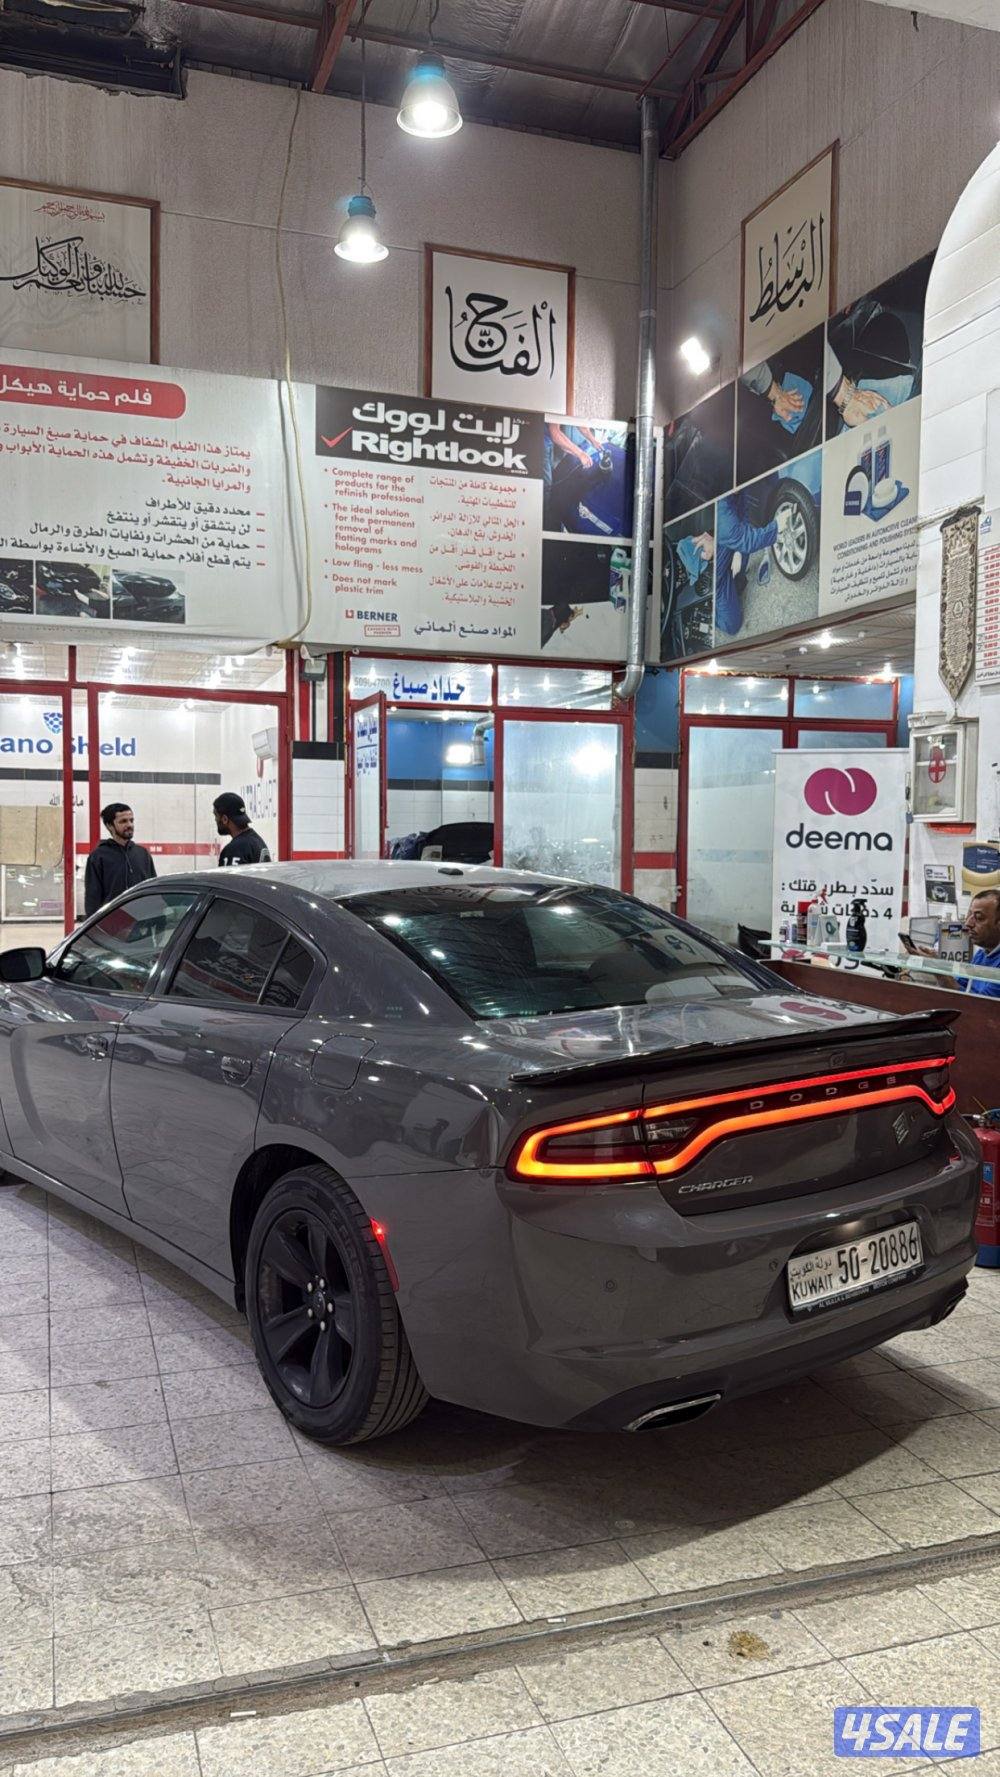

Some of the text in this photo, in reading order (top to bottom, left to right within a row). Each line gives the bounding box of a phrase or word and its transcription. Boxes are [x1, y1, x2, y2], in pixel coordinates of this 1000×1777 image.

[58, 380, 110, 401] حماية
[114, 388, 152, 406] فلم
[352, 401, 520, 445] رايت لووك
[3, 422, 251, 459] يمتاز هذا الفيلم الشفاف في حماية صبغ السيارة
[48, 443, 90, 457] الحماية
[92, 448, 115, 460] هذه
[351, 429, 526, 470] Rightlook
[157, 454, 199, 469] الخفيفة
[201, 460, 251, 477] والضربات
[332, 467, 415, 484] Complete range of
[211, 479, 251, 493] والمرايا
[335, 479, 406, 492] products for the
[335, 488, 425, 504] refinish professional
[193, 502, 220, 514] دقيق
[222, 506, 251, 517] محدد
[332, 503, 410, 518] The ideal solution
[106, 510, 139, 525] ينتفخ
[153, 515, 187, 530] يتقشر
[335, 513, 415, 528] for the permanent
[200, 520, 236, 535] يتشقق
[239, 524, 250, 535] لن
[335, 524, 384, 535] removal of
[29, 522, 250, 551] حماية من الحشرات ونفايات الطرق والرمال
[335, 532, 417, 548] flatting marks and
[11, 536, 54, 553] بواسطة
[107, 544, 139, 559] الصبغ
[335, 542, 382, 554] holograms
[142, 547, 176, 561] حماية
[206, 554, 231, 568] قطع
[232, 556, 251, 569] يتم
[332, 558, 350, 567] Low
[353, 559, 373, 571] fling
[382, 561, 399, 572] less
[401, 565, 423, 574] mess
[332, 573, 398, 587] Does not mark
[335, 583, 384, 595] plastic trim
[357, 610, 399, 622] BERNER
[458, 623, 489, 638] صنع
[491, 625, 516, 639] المواد
[393, 672, 429, 700] صباغ
[785, 822, 893, 851] deema
[749, 1075, 897, 1110] DODGE
[678, 1174, 754, 1195] CHARGER
[836, 1226, 919, 1284] 50-20886
[791, 1273, 833, 1301] KUWAIT
